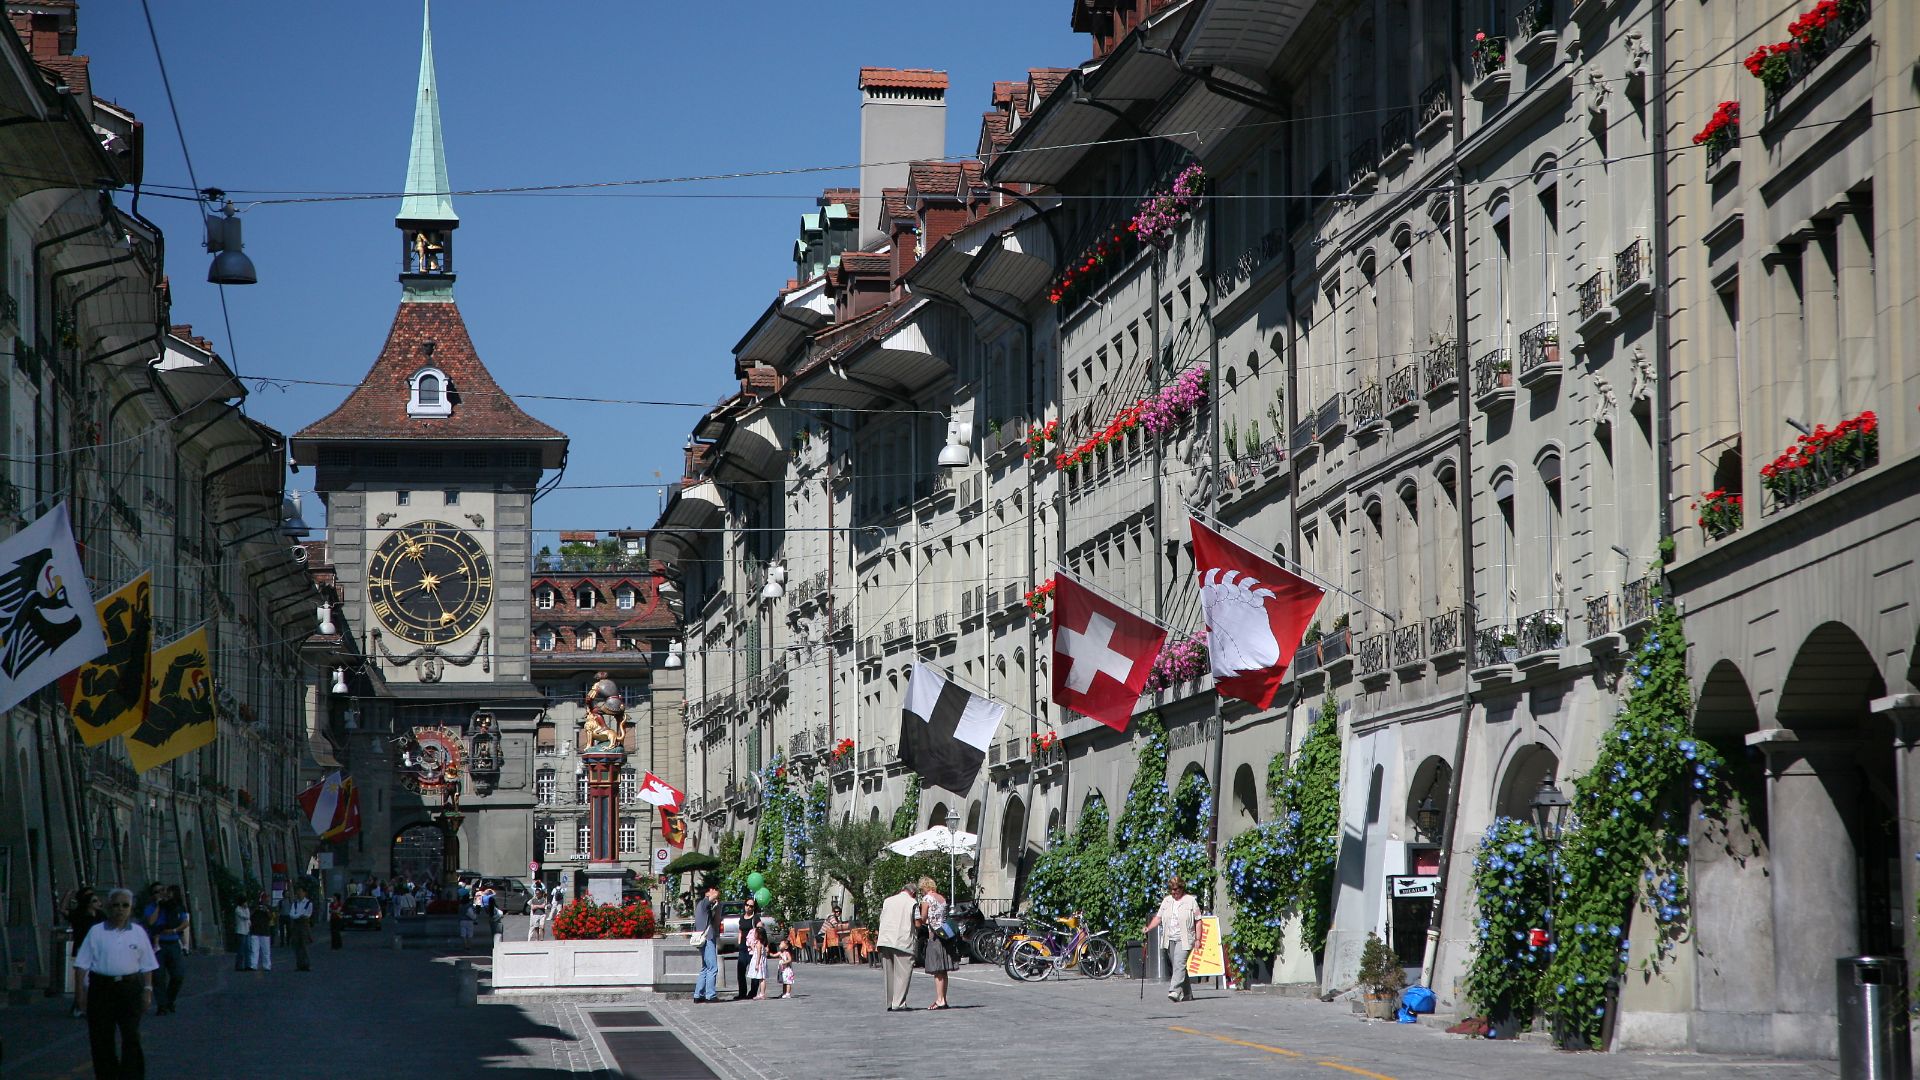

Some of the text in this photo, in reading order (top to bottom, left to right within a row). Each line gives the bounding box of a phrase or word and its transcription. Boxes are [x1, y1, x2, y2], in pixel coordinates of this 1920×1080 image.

[423, 522, 436, 535] XII
[453, 530, 461, 541] I
[377, 550, 387, 561] X
[369, 575, 382, 587] IX
[479, 577, 491, 588] III
[374, 600, 390, 618] VIII
[393, 621, 409, 636] VII
[452, 625, 463, 636] V
[424, 630, 435, 642] VI
